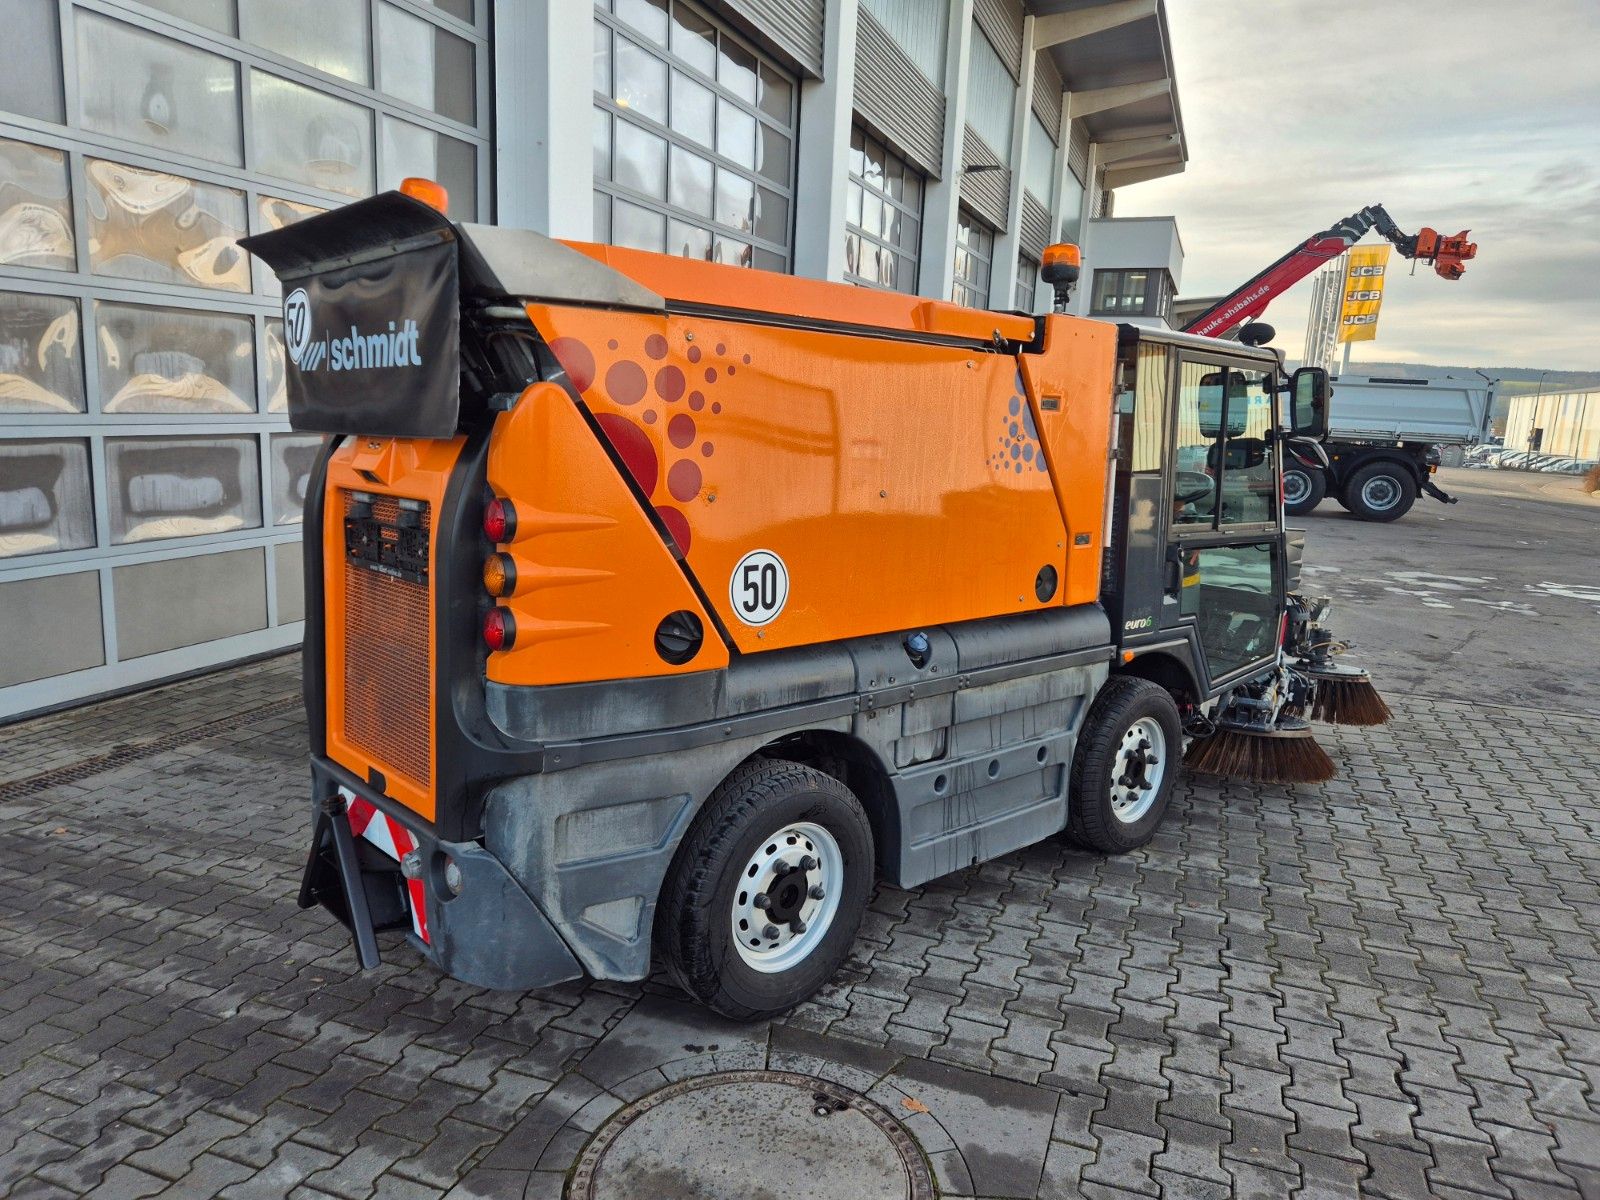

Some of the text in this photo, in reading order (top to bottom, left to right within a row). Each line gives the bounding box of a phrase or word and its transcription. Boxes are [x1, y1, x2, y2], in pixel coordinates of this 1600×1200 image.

[1350, 266, 1384, 277] JCB
[1196, 285, 1270, 336] hauke-ahsbahs.de
[1347, 290, 1381, 301] JCB
[287, 302, 306, 348] 50
[1343, 314, 1377, 325] JCB
[330, 319, 422, 371] schmidt
[743, 563, 777, 612] 50
